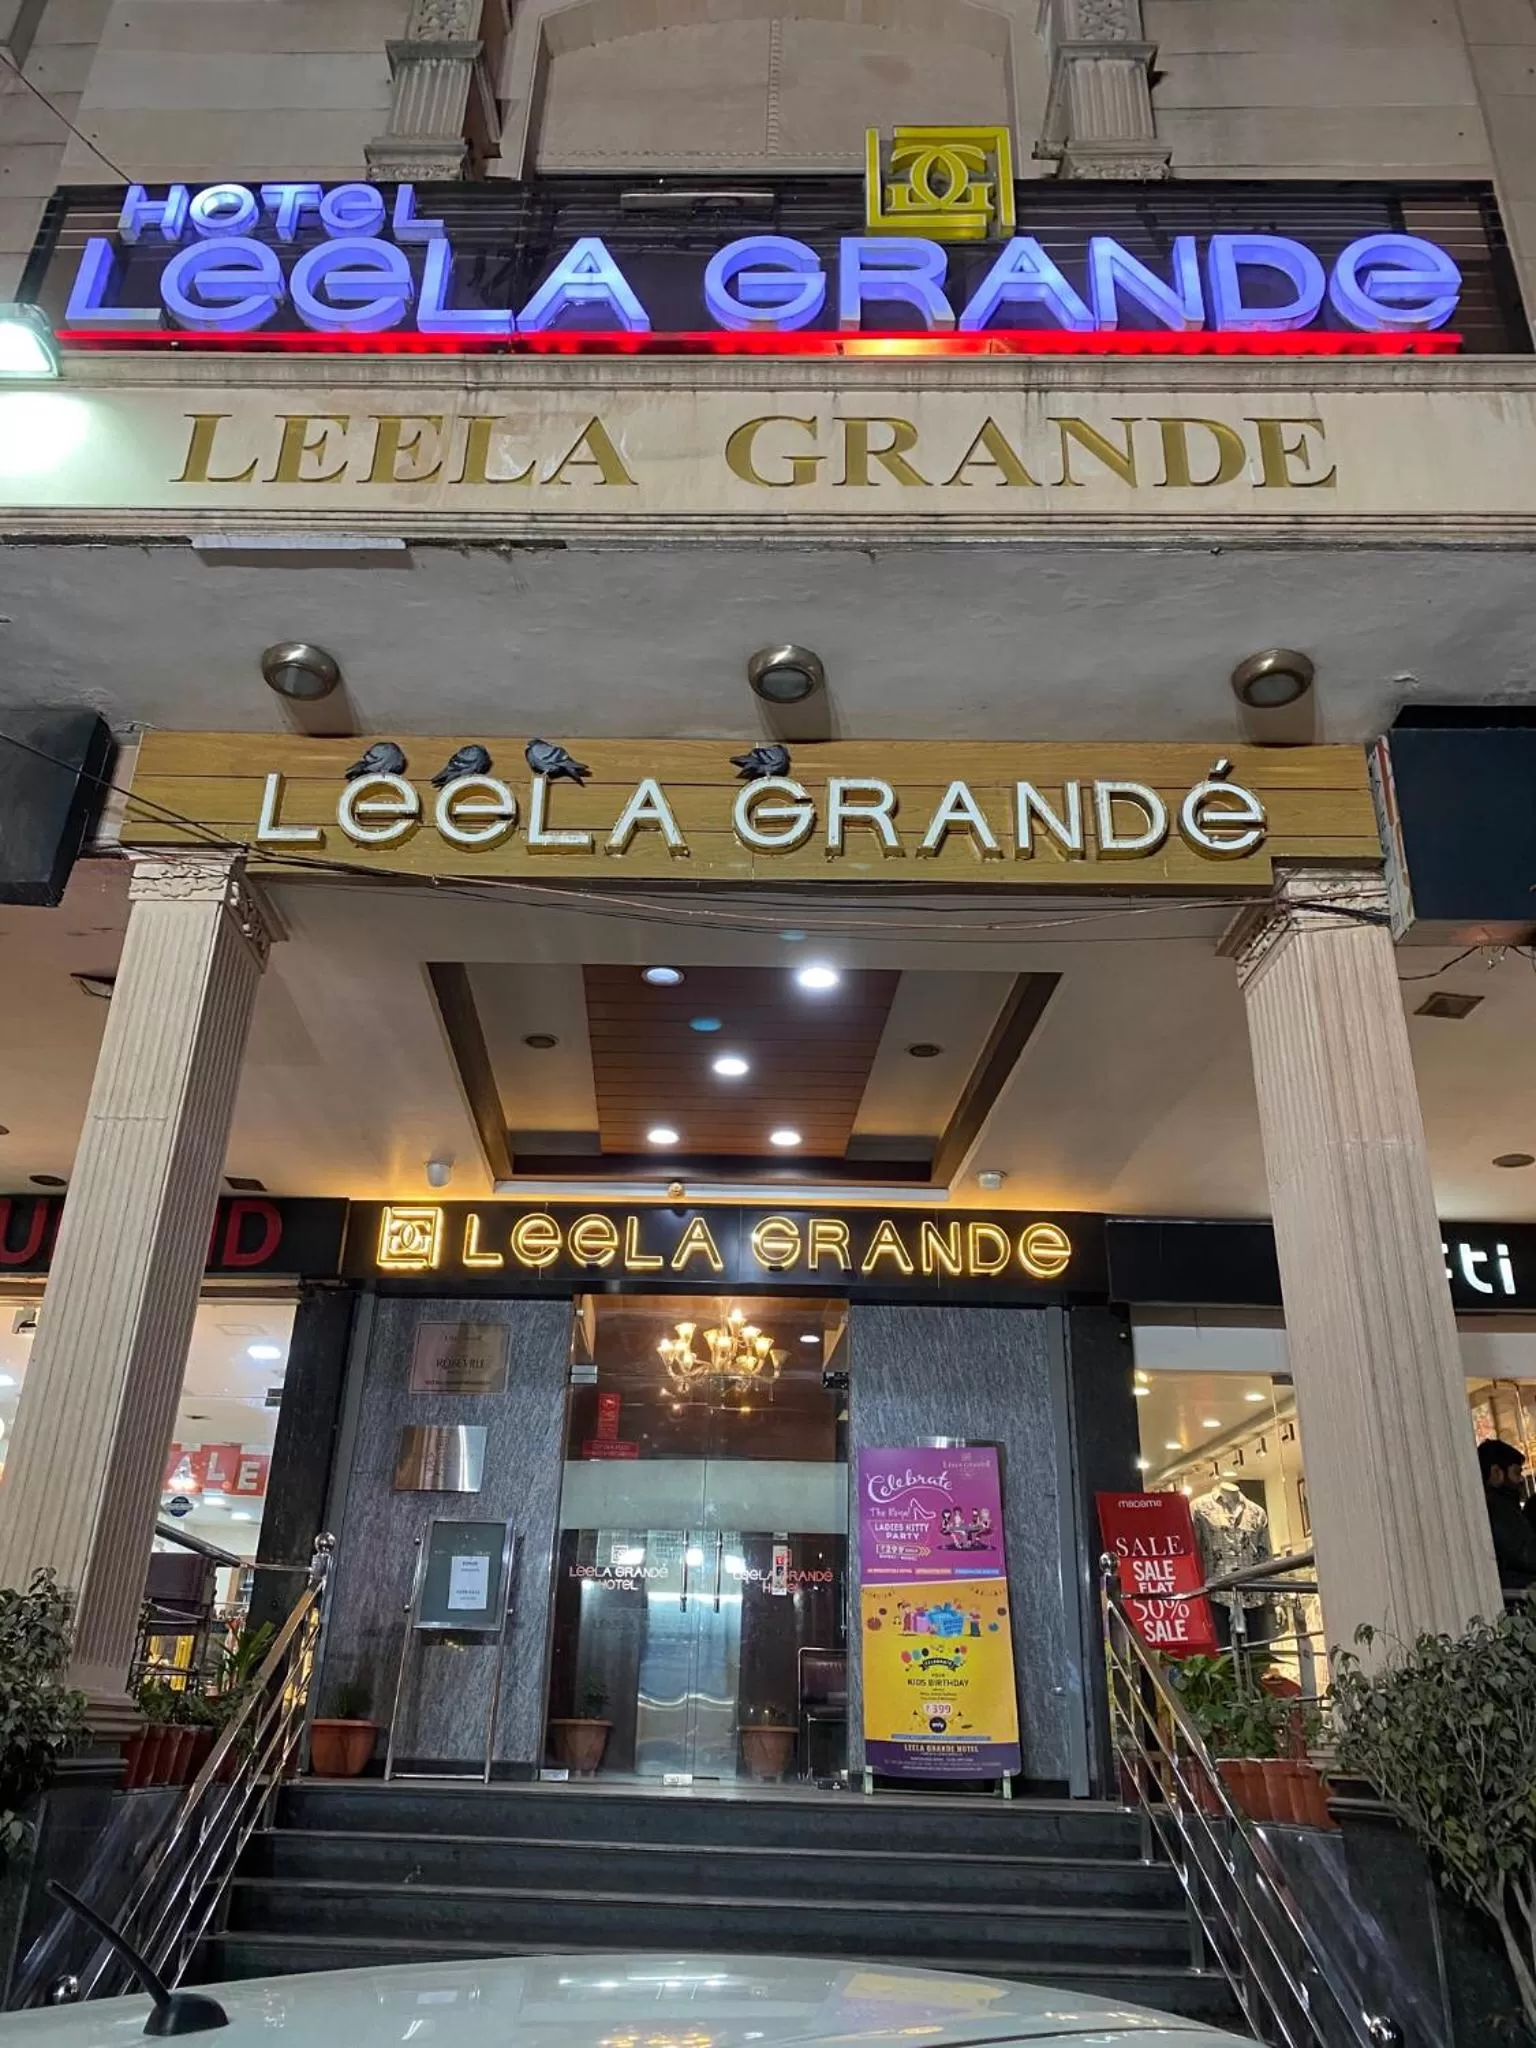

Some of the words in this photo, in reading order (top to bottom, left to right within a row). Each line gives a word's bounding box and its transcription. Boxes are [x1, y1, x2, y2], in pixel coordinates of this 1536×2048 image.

[170, 413, 639, 486] LEELA
[724, 415, 1337, 490] GRANDE
[866, 1469, 953, 1503] Celebrate
[1118, 1498, 1163, 1508] madame
[874, 1523, 904, 1532] LADIES
[905, 1523, 929, 1533] KITTY
[886, 1532, 920, 1541] PARTY
[1115, 1535, 1185, 1557] SALE
[1132, 1559, 1176, 1582] SALE
[1138, 1582, 1175, 1594] FLAT
[1133, 1599, 1191, 1622] 50%
[1144, 1619, 1189, 1643] SALE
[908, 1679, 927, 1687] KIDS
[928, 1679, 969, 1687] BIRTHDAY
